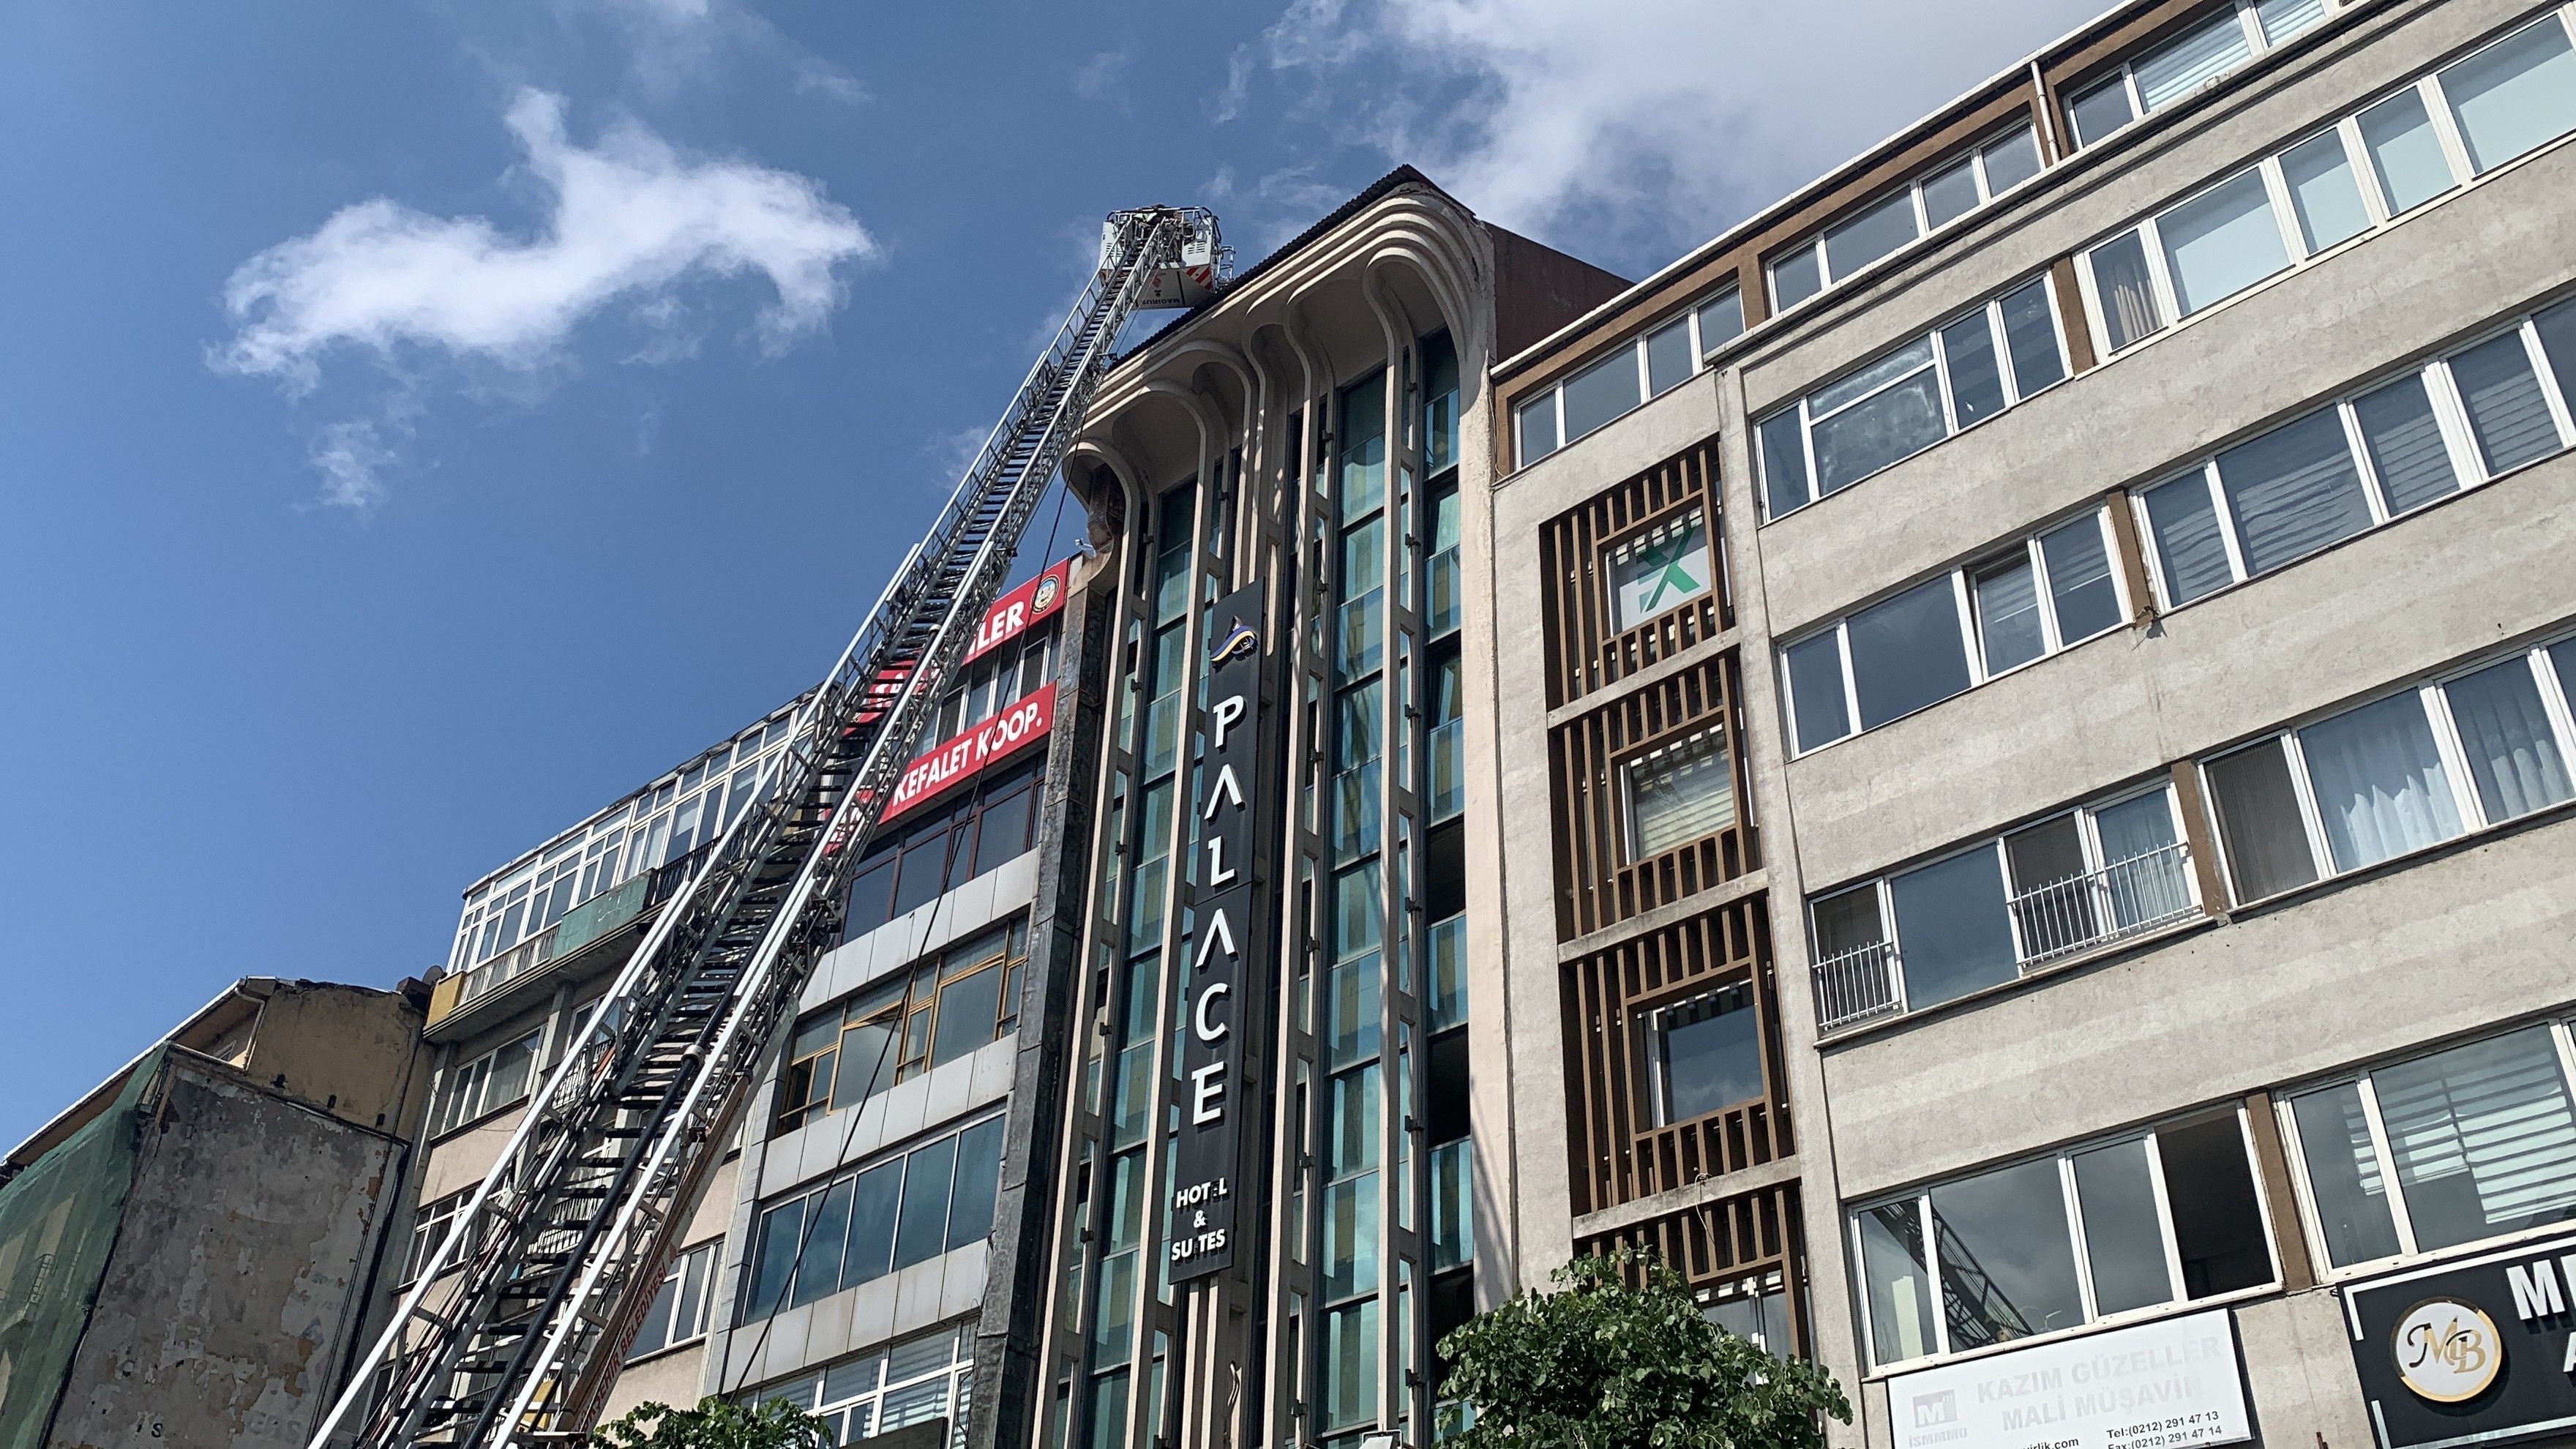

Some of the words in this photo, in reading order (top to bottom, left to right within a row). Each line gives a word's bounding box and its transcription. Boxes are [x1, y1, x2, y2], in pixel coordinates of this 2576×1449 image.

[1142, 297, 1180, 305] MAGIRUS
[892, 738, 973, 807] KEFALET
[976, 702, 1041, 758] KOOP.
[1191, 694, 1244, 1126] PALACE
[1176, 1177, 1227, 1208] HOTL
[1194, 1210, 1207, 1228] &
[1171, 1229, 1226, 1261] SUTES
[1977, 1367, 2063, 1404] KAZIM
[2072, 1336, 2221, 1384] GÜZELLER
[2002, 1394, 2066, 1431] MALİ
[2165, 1417, 2184, 1429] 291
[2188, 1414, 2201, 1424] 47
[2205, 1411, 2219, 1420] 13
[2168, 1431, 2187, 1443] 291
[2192, 1428, 2204, 1438] 47
[2209, 1425, 2223, 1435] 14
